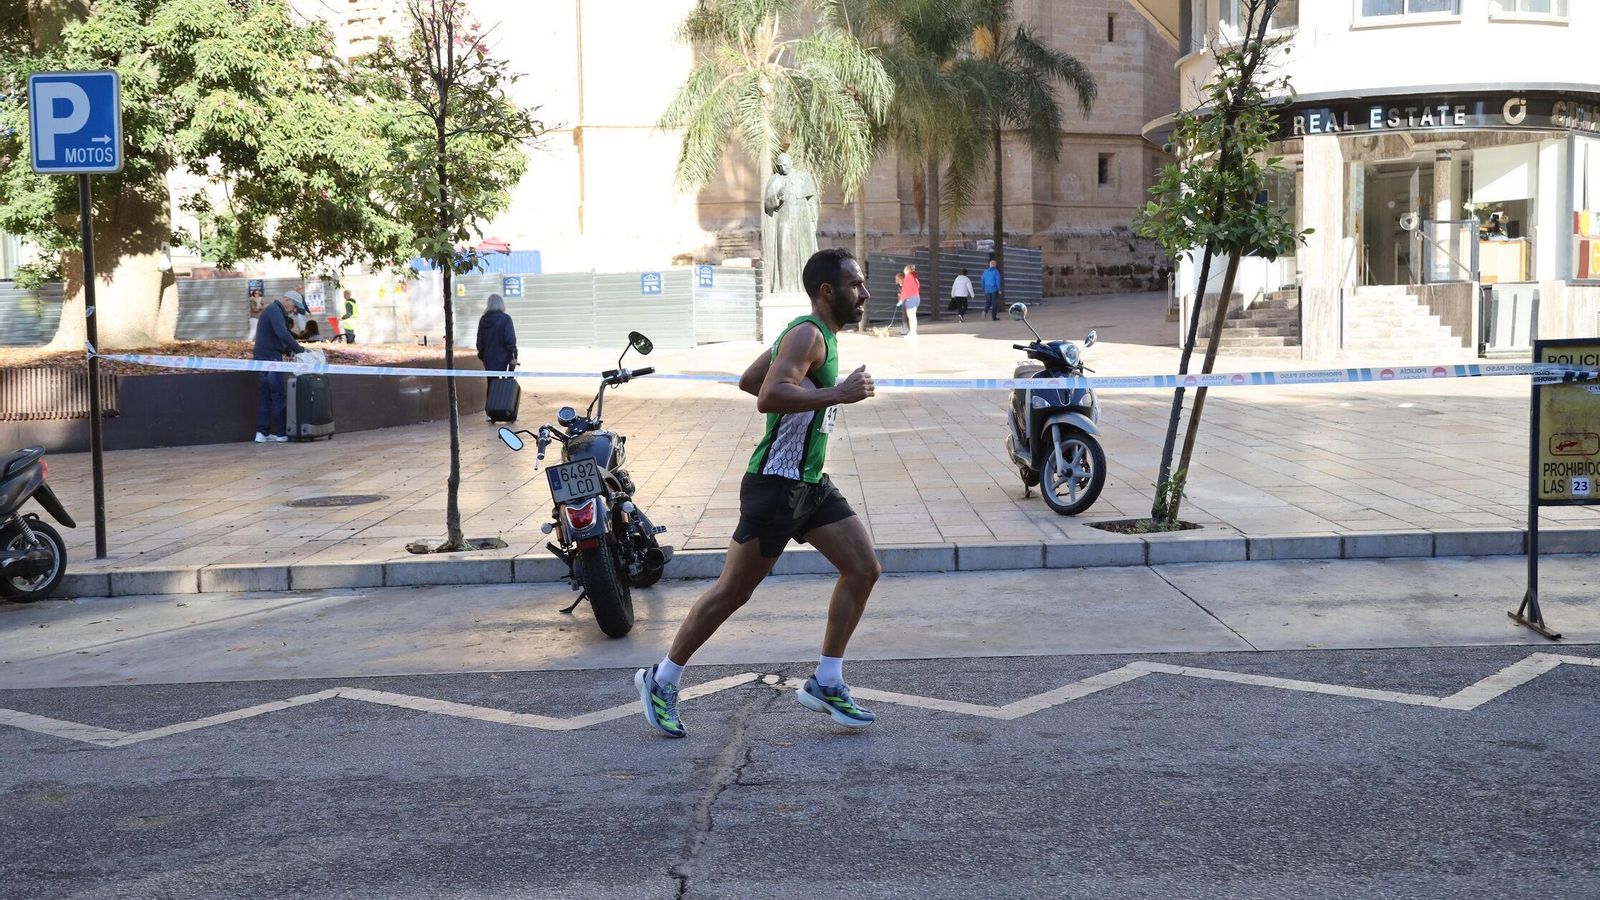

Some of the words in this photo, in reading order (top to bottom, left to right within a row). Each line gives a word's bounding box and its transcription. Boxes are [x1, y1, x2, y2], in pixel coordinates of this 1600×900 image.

[35, 82, 91, 161] P
[1293, 111, 1355, 135] REAL
[1369, 105, 1466, 129] ESTATE
[65, 147, 114, 163] MOTOS
[561, 463, 595, 482] 6492
[568, 479, 595, 496] LCD
[1543, 479, 1565, 494] LAS
[1573, 481, 1588, 491] 23
